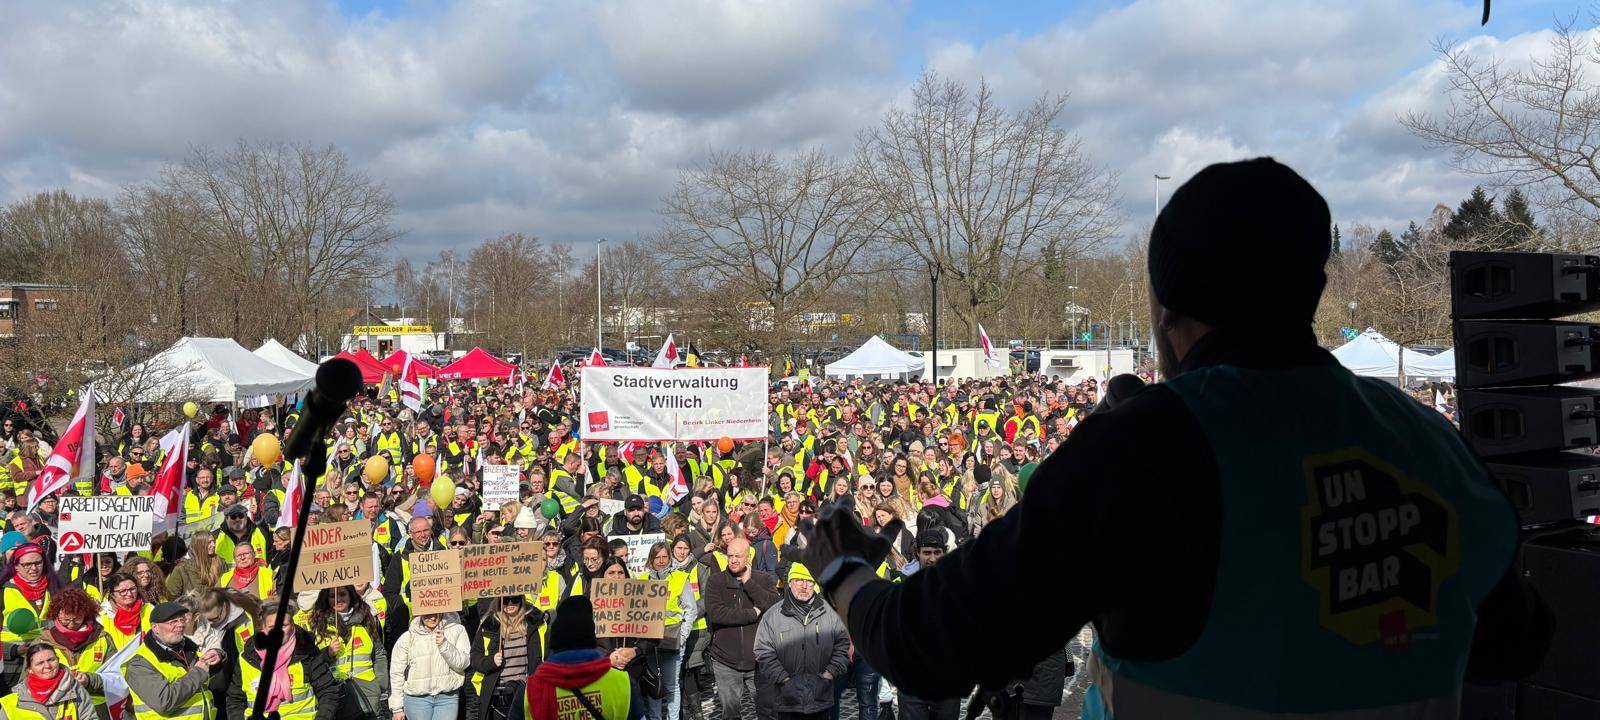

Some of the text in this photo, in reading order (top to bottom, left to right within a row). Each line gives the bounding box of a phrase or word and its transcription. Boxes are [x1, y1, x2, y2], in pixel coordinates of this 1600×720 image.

[613, 374, 738, 390] Stadtverwaltung
[650, 394, 702, 409] Willich
[1322, 469, 1368, 508] UN
[61, 496, 155, 513] ARBEITSAGENTUR
[303, 526, 342, 548] INDER
[1317, 503, 1422, 557] STOPP
[313, 549, 345, 564] KNETE
[418, 552, 440, 562] GUTE
[463, 544, 520, 558] MIT EINEM
[412, 562, 449, 574] BILDUNG
[464, 553, 539, 570] ANGEBOT WÄRE
[301, 565, 360, 585] WIR AUCH
[464, 566, 532, 579] ICH HEUTE ZUR
[1337, 555, 1401, 601] BAR
[427, 577, 443, 586] NICHT
[463, 579, 492, 592] ARBEIT
[479, 582, 538, 597] GEGANGEN
[595, 582, 668, 597] ICH BIN SO
[420, 598, 452, 607] ANGEBOT
[593, 598, 648, 610] SAUER ICH
[593, 610, 664, 622] HABE SOGAR
[595, 623, 649, 635] IN SCHILD
